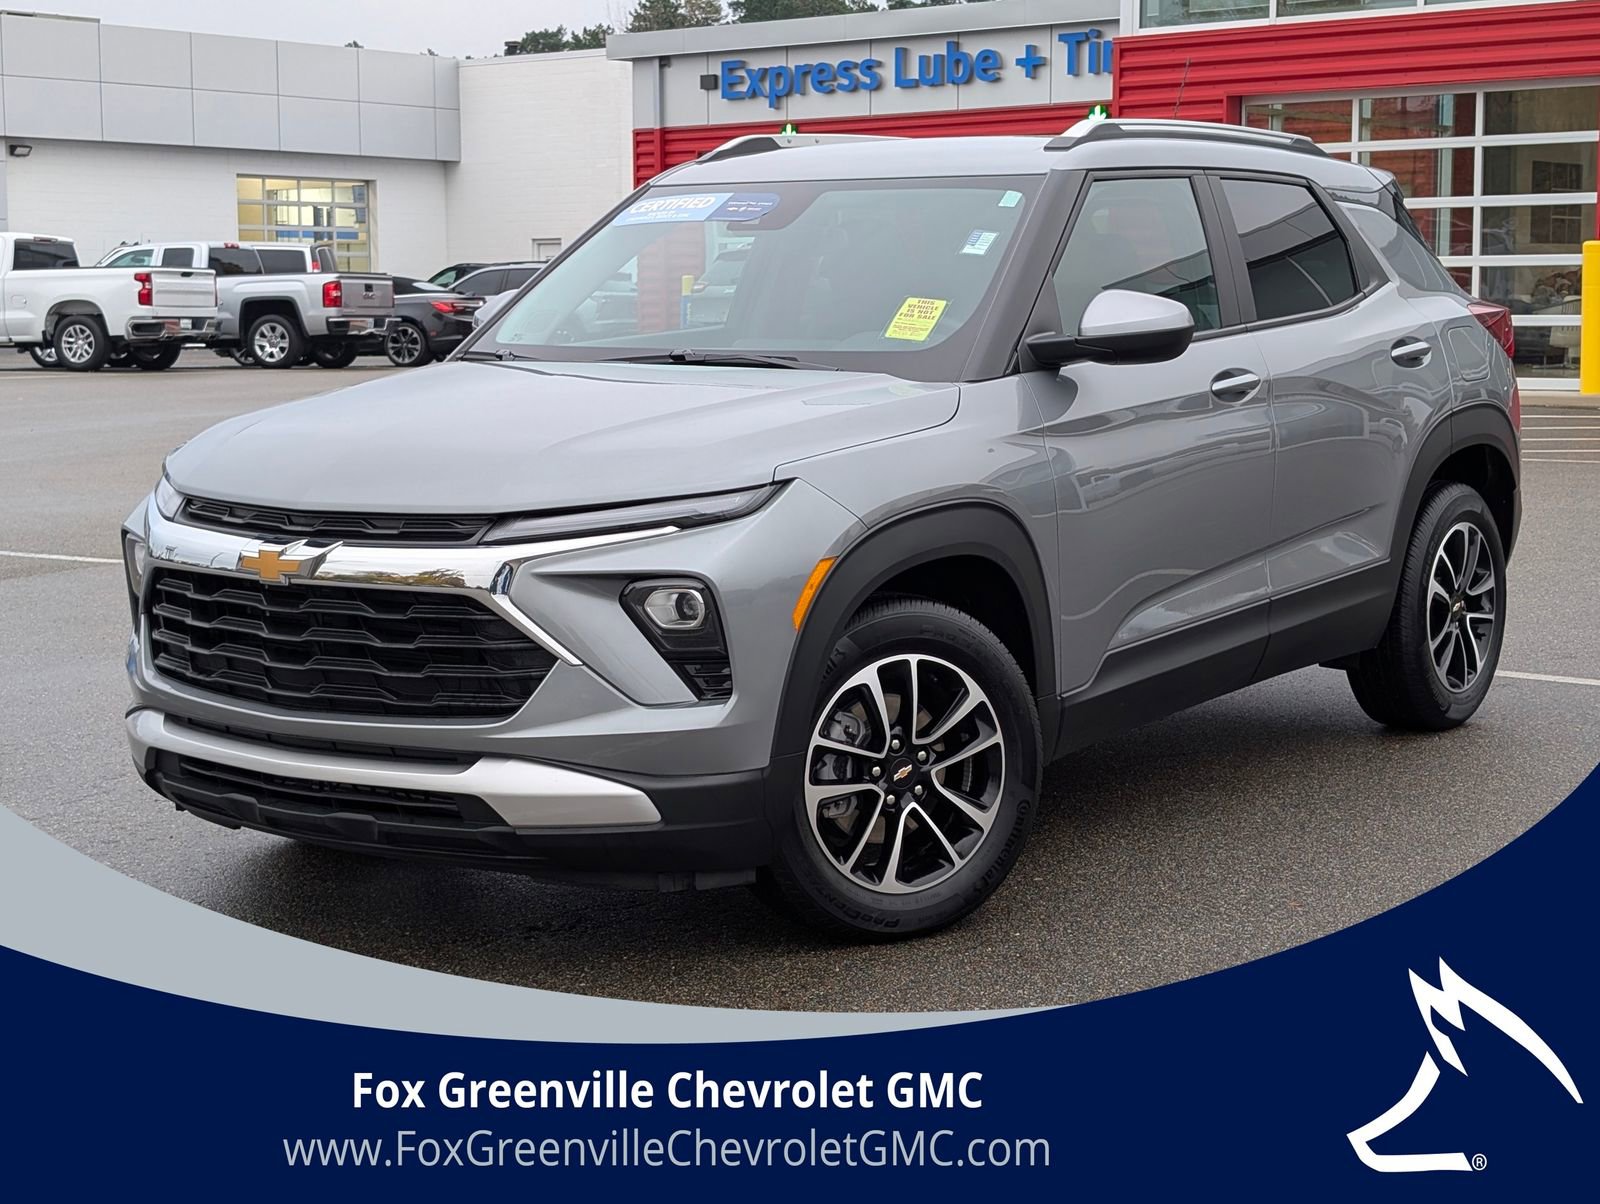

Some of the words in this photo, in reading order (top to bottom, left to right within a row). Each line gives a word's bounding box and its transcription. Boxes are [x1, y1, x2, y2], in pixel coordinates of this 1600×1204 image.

[720, 56, 881, 109] Express
[894, 41, 1001, 89] Lube
[1015, 44, 1047, 79] +
[631, 197, 716, 213] CERTIFIED
